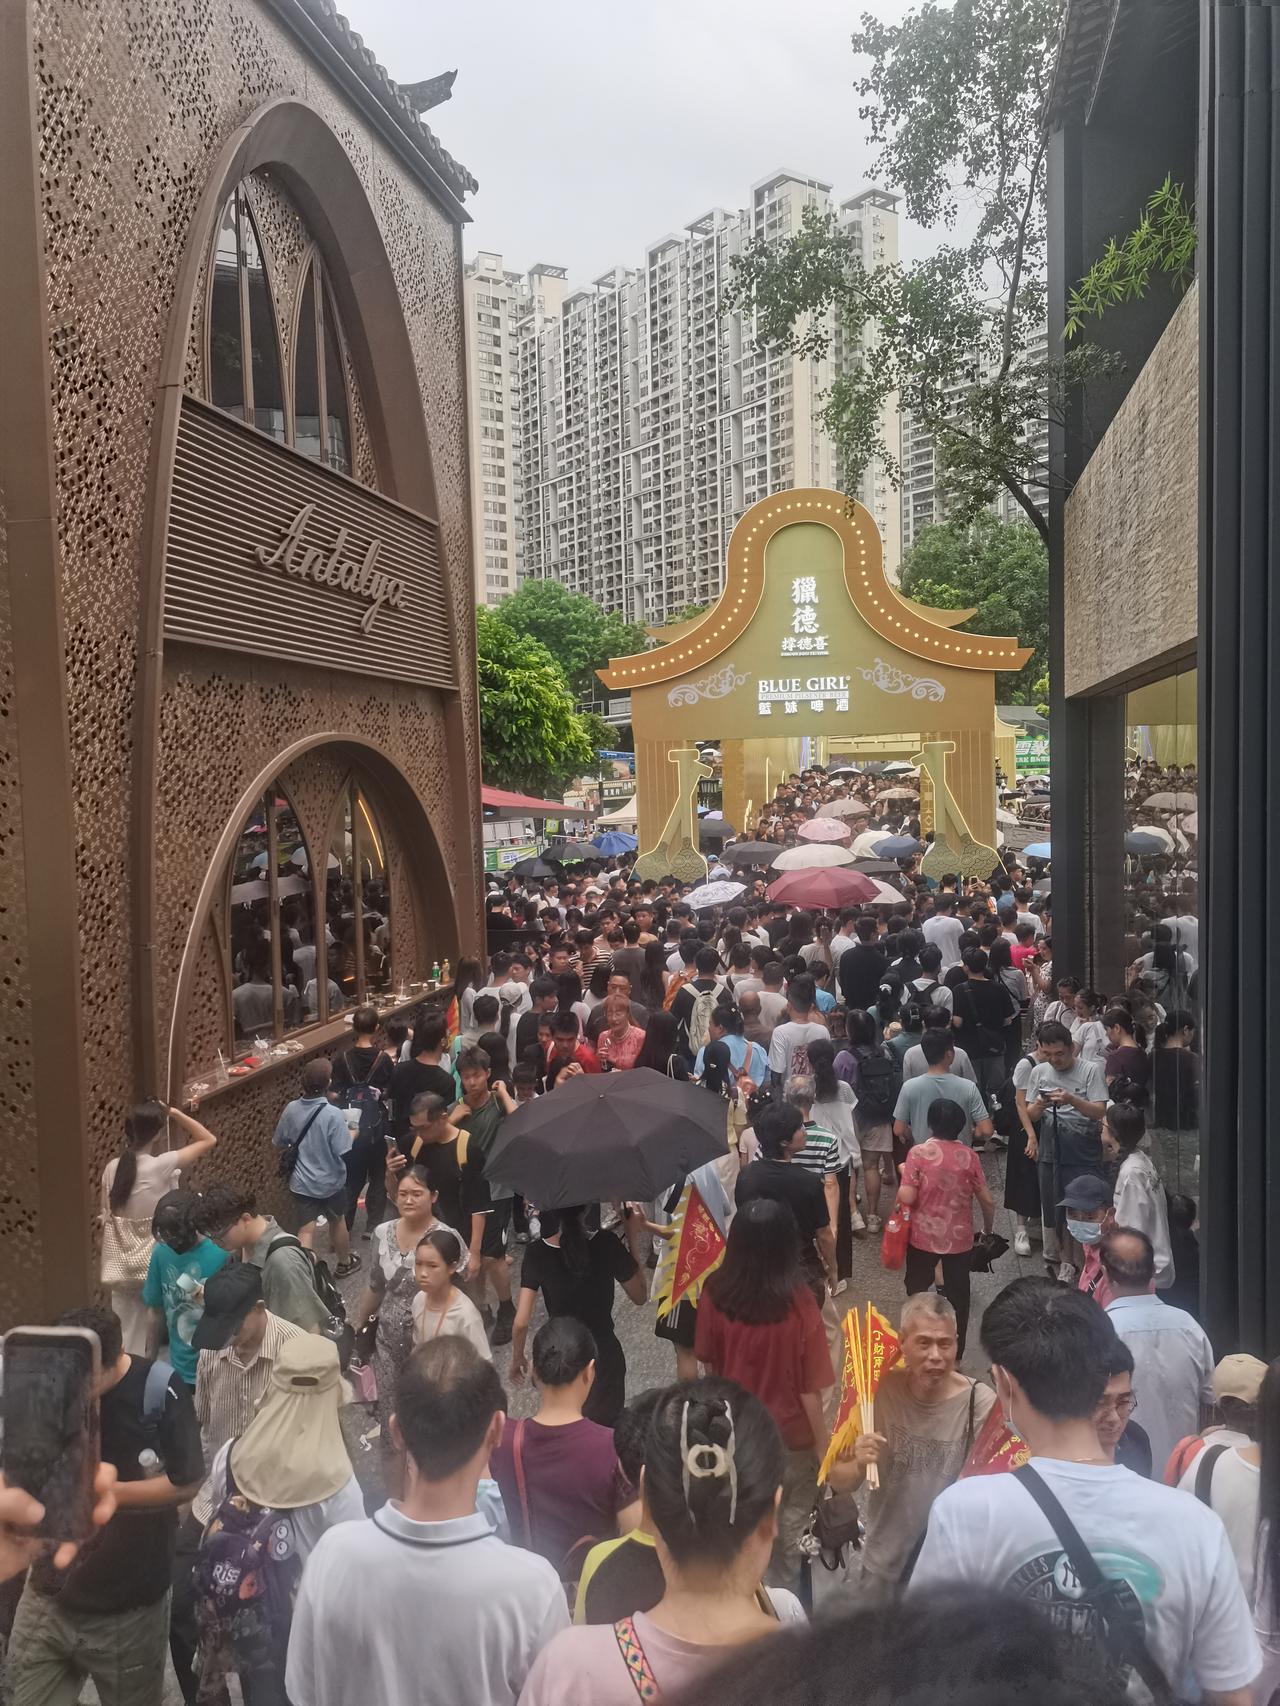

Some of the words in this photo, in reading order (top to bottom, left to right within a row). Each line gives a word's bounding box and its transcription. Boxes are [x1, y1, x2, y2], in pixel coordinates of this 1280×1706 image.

[255, 503, 408, 634] Antalya
[791, 576, 820, 634] 獵德
[758, 678, 801, 693] BLUE
[758, 699, 849, 715] 藍妹啤酒
